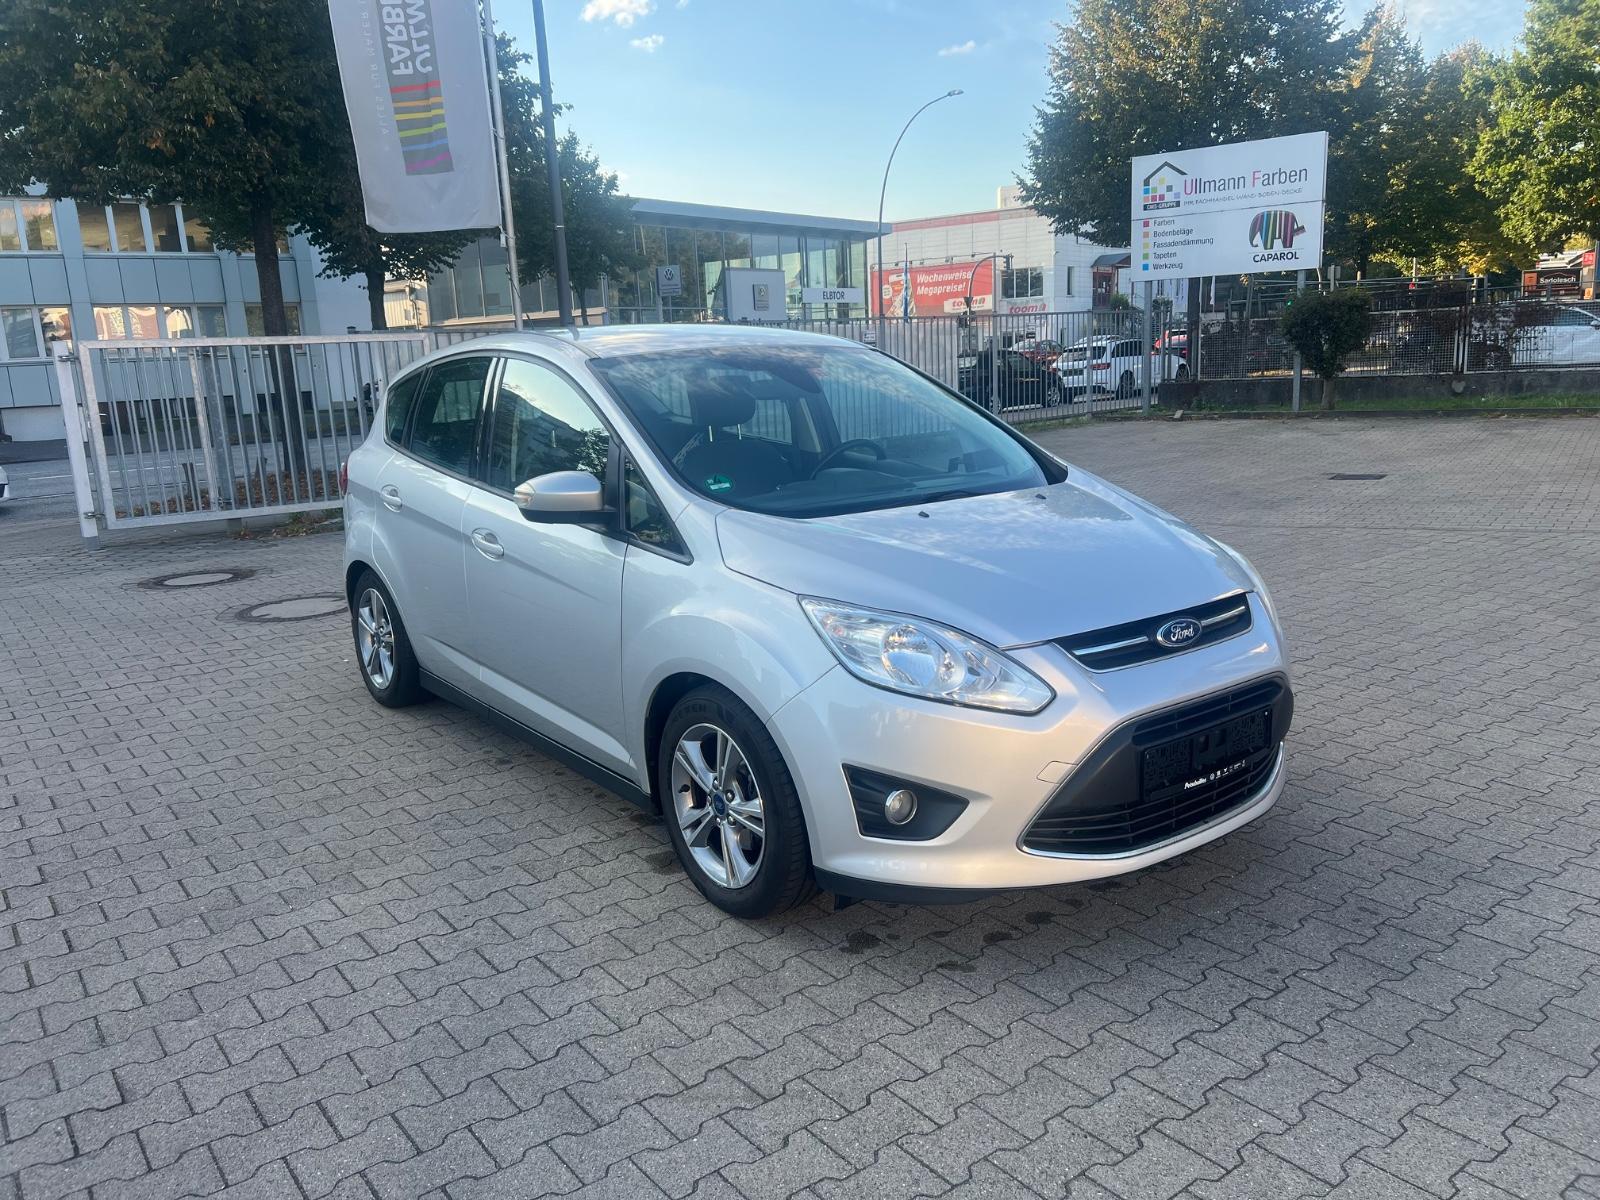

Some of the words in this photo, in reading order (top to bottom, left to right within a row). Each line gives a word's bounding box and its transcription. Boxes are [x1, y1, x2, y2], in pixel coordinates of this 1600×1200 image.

[1184, 175, 1246, 196] Ullmann
[1252, 167, 1308, 188] Farben
[1153, 218, 1175, 227] Farben
[1153, 228, 1194, 238] Bodenbeläge
[1153, 238, 1214, 249] Fassadendämmung
[1153, 251, 1177, 260] Tapeten
[1252, 251, 1300, 263] CAPAROL
[1152, 262, 1184, 271] Werkzeug
[916, 269, 972, 284] Wochenweise
[916, 281, 967, 297] Megapreise!
[822, 290, 845, 300] ELBTOR
[1008, 303, 1039, 314] toom
[1170, 622, 1195, 642] Ford
